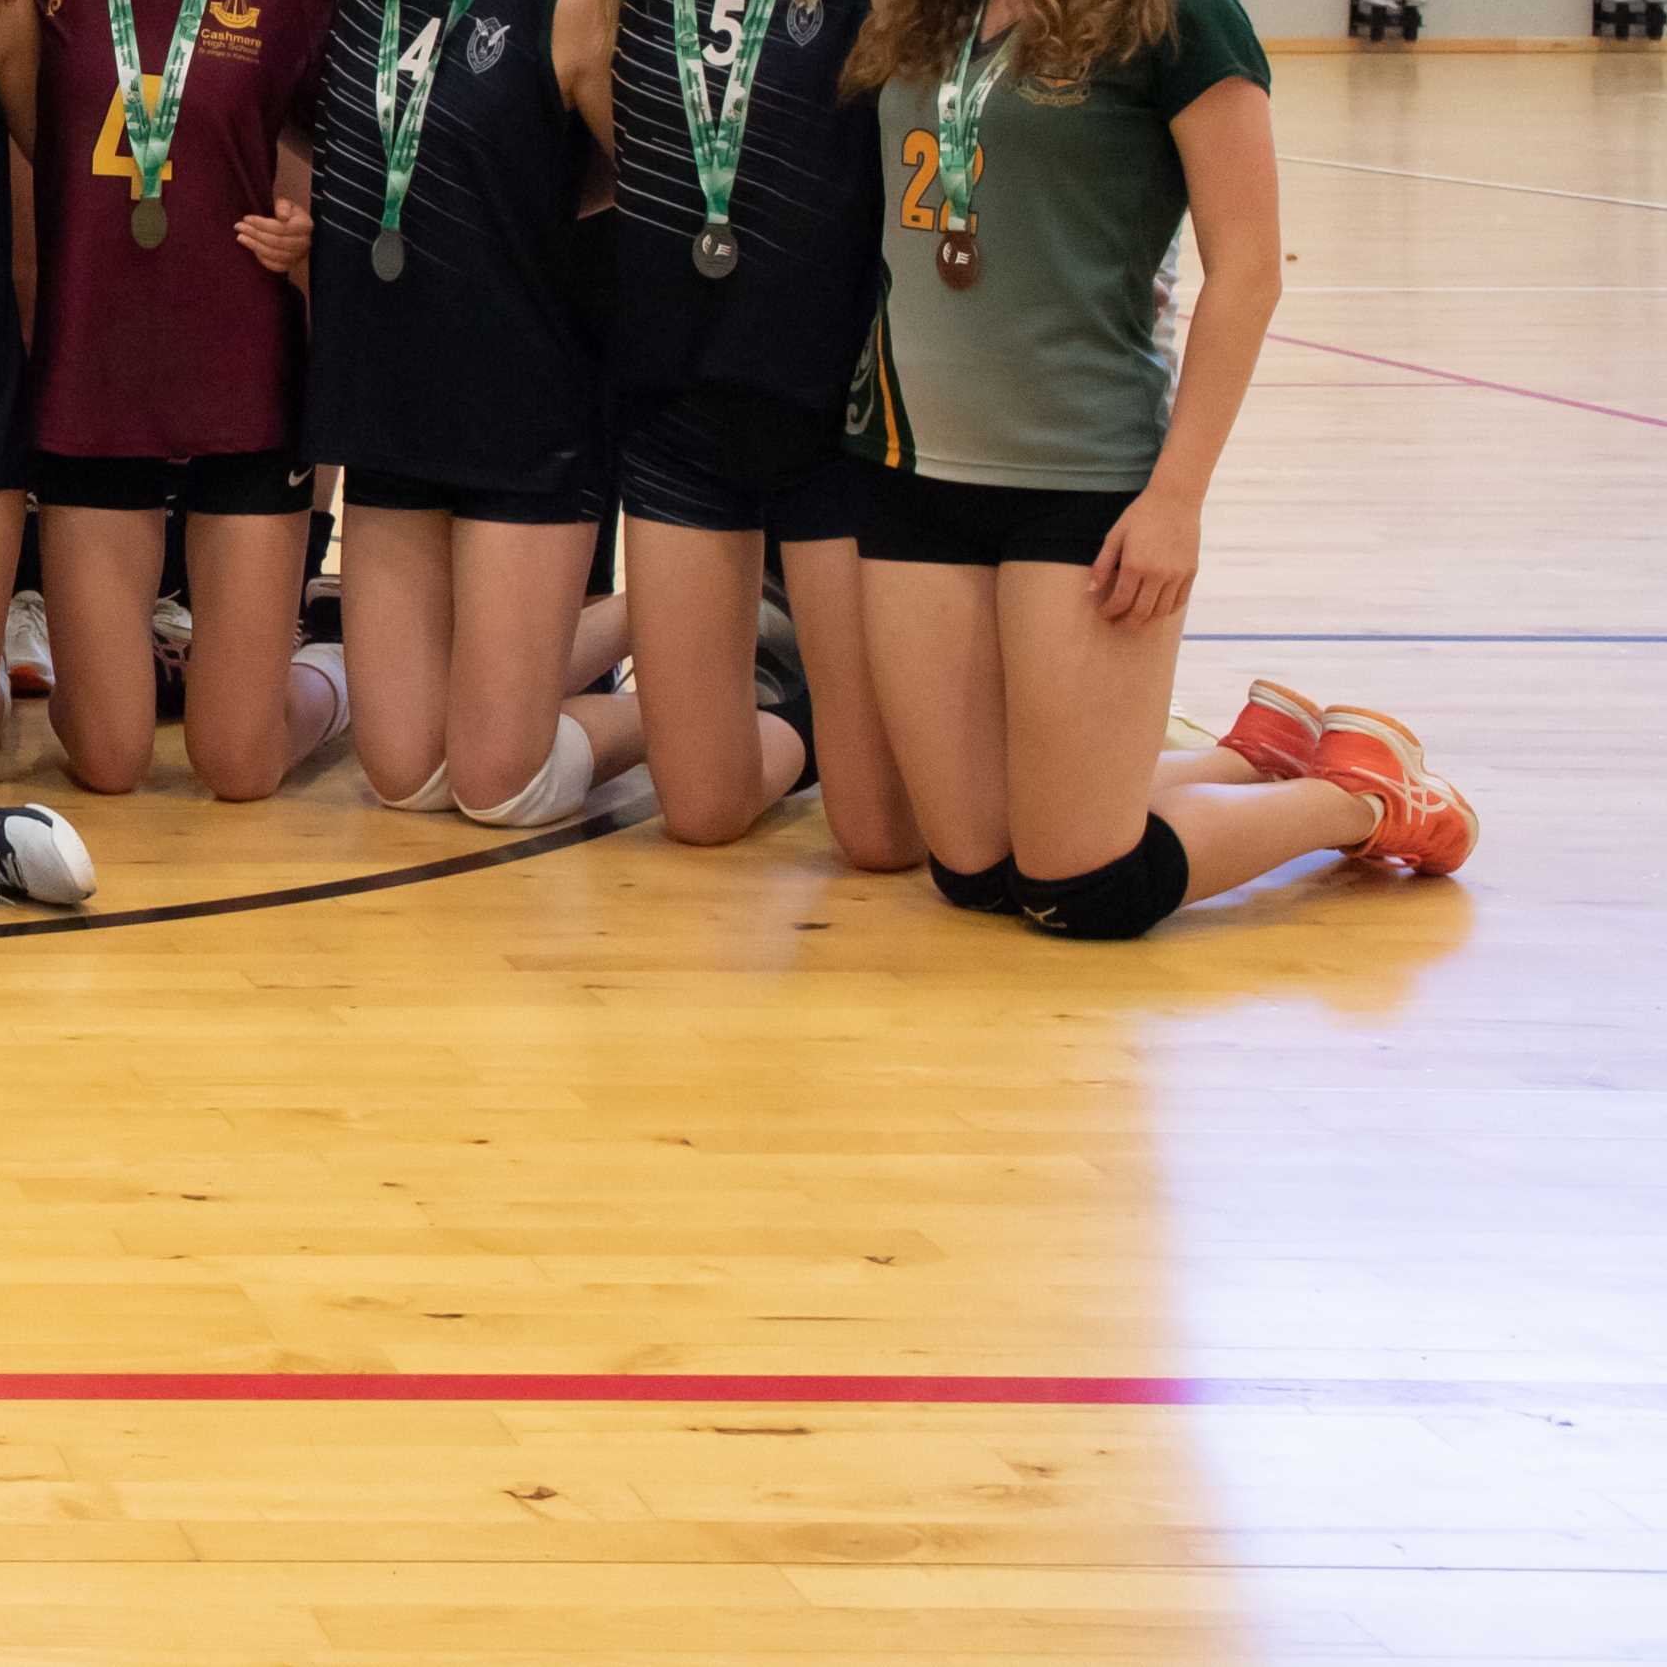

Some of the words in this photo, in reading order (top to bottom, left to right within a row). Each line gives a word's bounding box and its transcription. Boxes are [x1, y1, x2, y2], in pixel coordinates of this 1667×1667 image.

[201, 28, 263, 48] Cashmere
[397, 18, 442, 82] 4
[92, 74, 173, 201] 4
